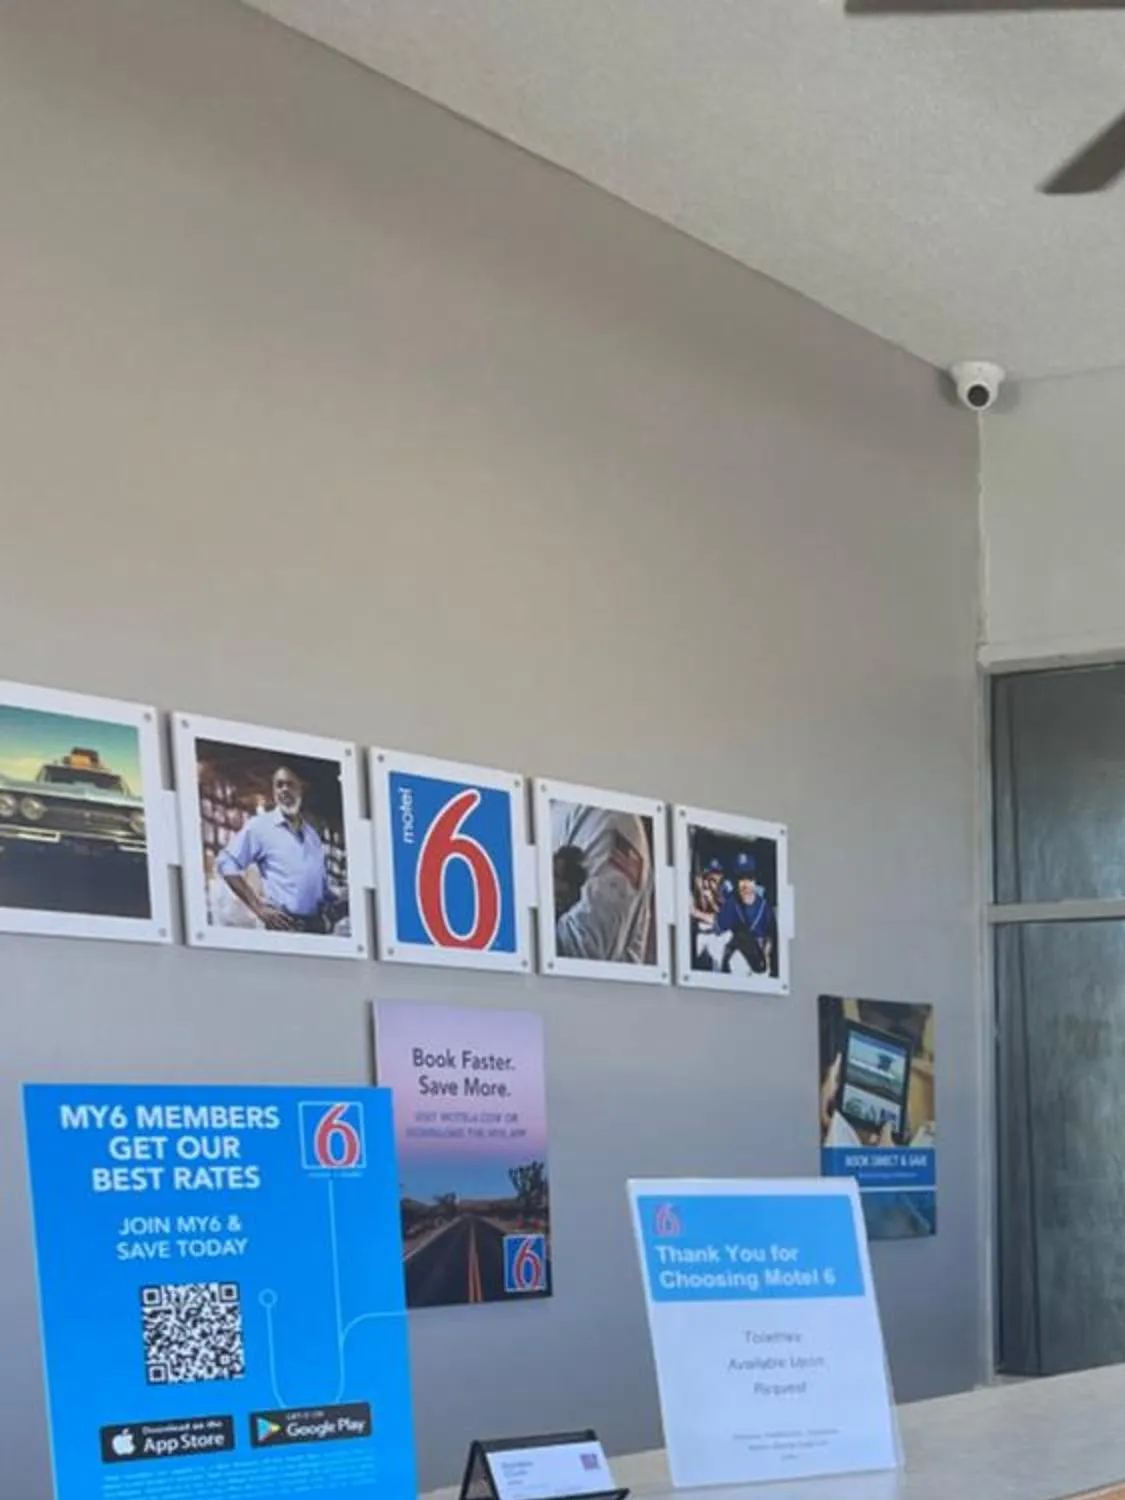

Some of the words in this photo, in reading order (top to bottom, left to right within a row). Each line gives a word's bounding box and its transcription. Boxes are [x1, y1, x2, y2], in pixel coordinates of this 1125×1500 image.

[399, 787, 414, 844] motel
[416, 788, 501, 952] 6
[412, 1048, 456, 1068] Book
[462, 1050, 516, 1071] Faster.
[419, 1075, 458, 1096] Save
[464, 1077, 512, 1097] More.
[60, 1105, 127, 1129] MY6
[136, 1105, 281, 1129] MEMBERS
[108, 1136, 169, 1160] GET
[177, 1135, 241, 1159] OUR
[314, 1103, 361, 1168] 6
[92, 1167, 164, 1192] BEST
[173, 1165, 261, 1190] RATES
[118, 1216, 171, 1236] JOIN
[176, 1215, 222, 1234] MY6
[227, 1214, 242, 1232] &
[116, 1241, 171, 1261] SAVE
[178, 1237, 248, 1259] TODAY
[655, 1244, 720, 1264] Thank
[725, 1244, 766, 1262] You
[770, 1244, 799, 1262] for
[514, 1236, 541, 1289] 6
[659, 1269, 759, 1290] Choosing
[764, 1267, 819, 1286] Motel
[823, 1267, 836, 1286] 6
[286, 1420, 335, 1439] Google
[337, 1416, 366, 1435] Play
[143, 1437, 180, 1456] App
[182, 1433, 225, 1450] Store
